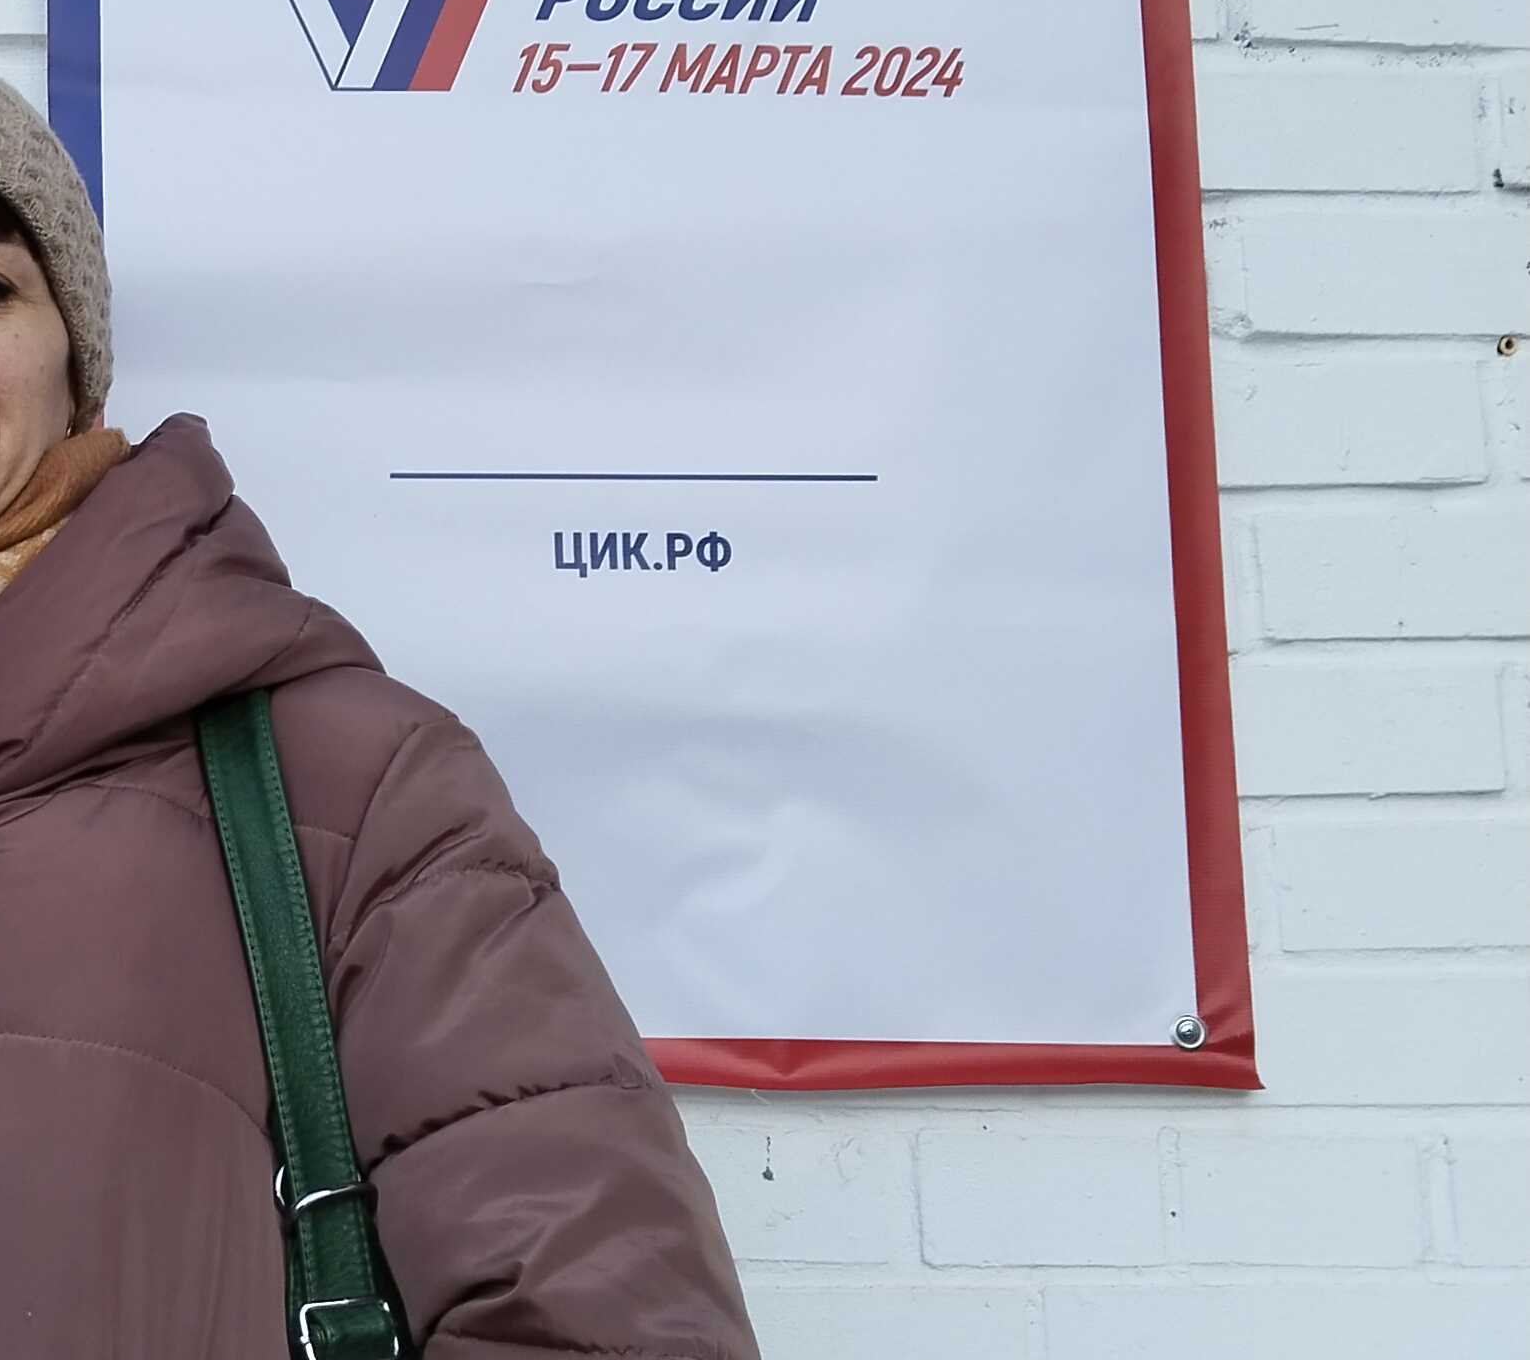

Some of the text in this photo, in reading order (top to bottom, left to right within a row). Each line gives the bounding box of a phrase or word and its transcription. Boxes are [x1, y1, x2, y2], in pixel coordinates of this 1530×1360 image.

[658, 42, 834, 97] МАРТА
[840, 44, 965, 99] 2024
[553, 530, 733, 579] ЦИК.РФ
